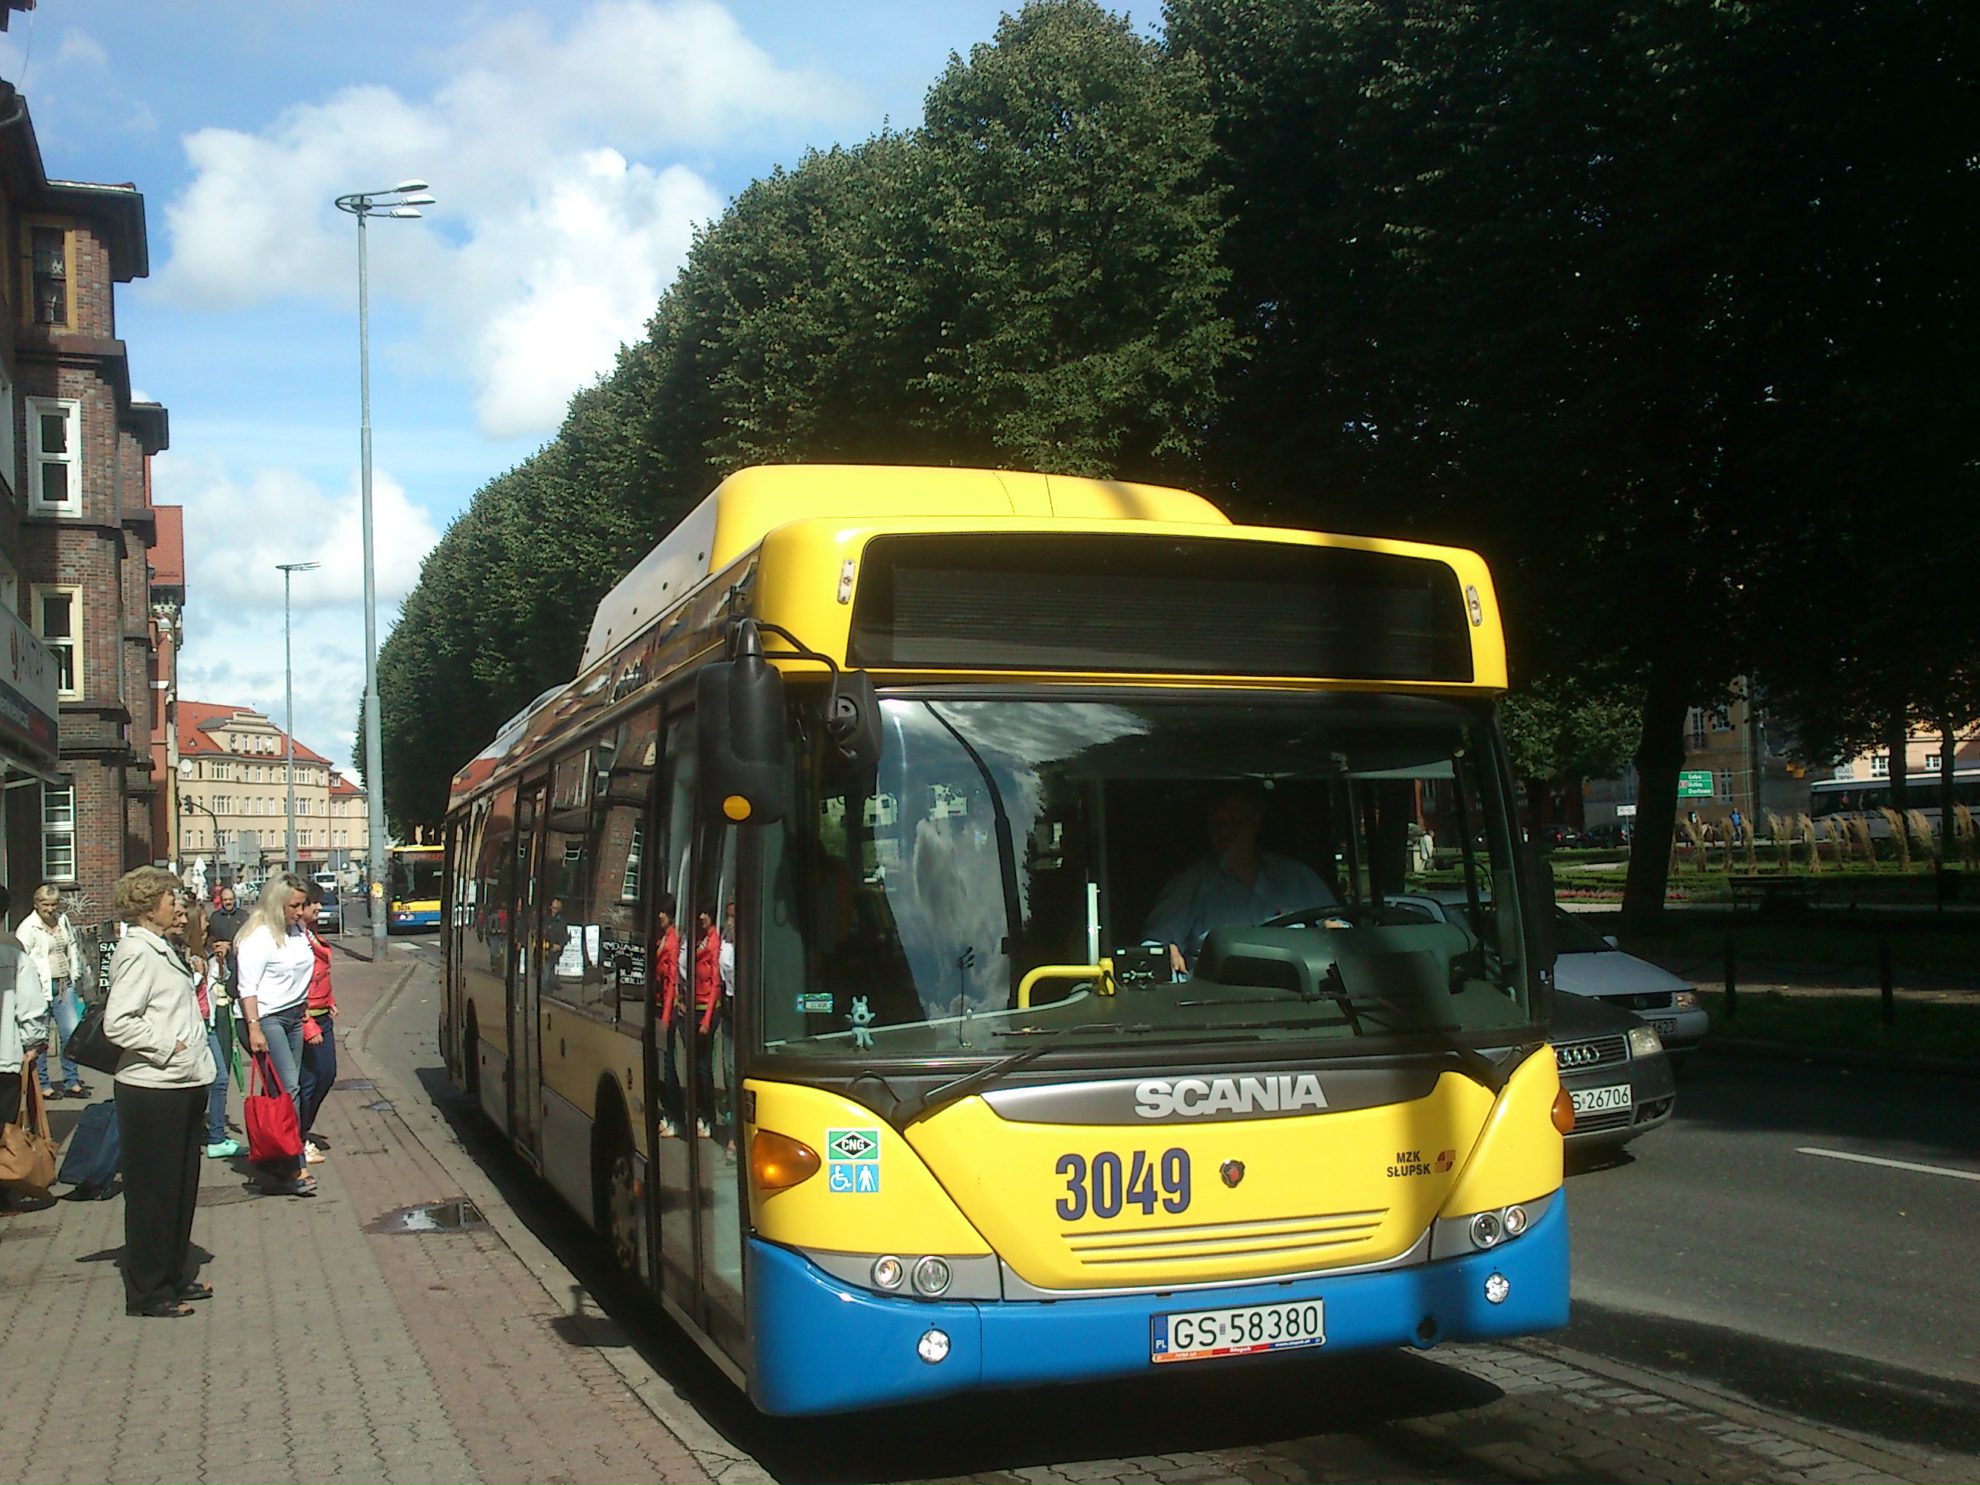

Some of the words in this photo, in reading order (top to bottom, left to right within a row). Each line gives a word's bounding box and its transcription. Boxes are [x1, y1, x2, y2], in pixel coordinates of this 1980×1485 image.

[1134, 1074, 1329, 1119] SCANIA
[1586, 1087, 1630, 1110] 26706
[841, 1138, 865, 1151] CNG
[1396, 1150, 1421, 1164] MZK
[1386, 1163, 1431, 1178] SŁUPSK
[1055, 1147, 1191, 1222] 3049
[1174, 1316, 1217, 1349] GS
[1230, 1306, 1318, 1344] 58380
[1155, 1339, 1168, 1349] PL
